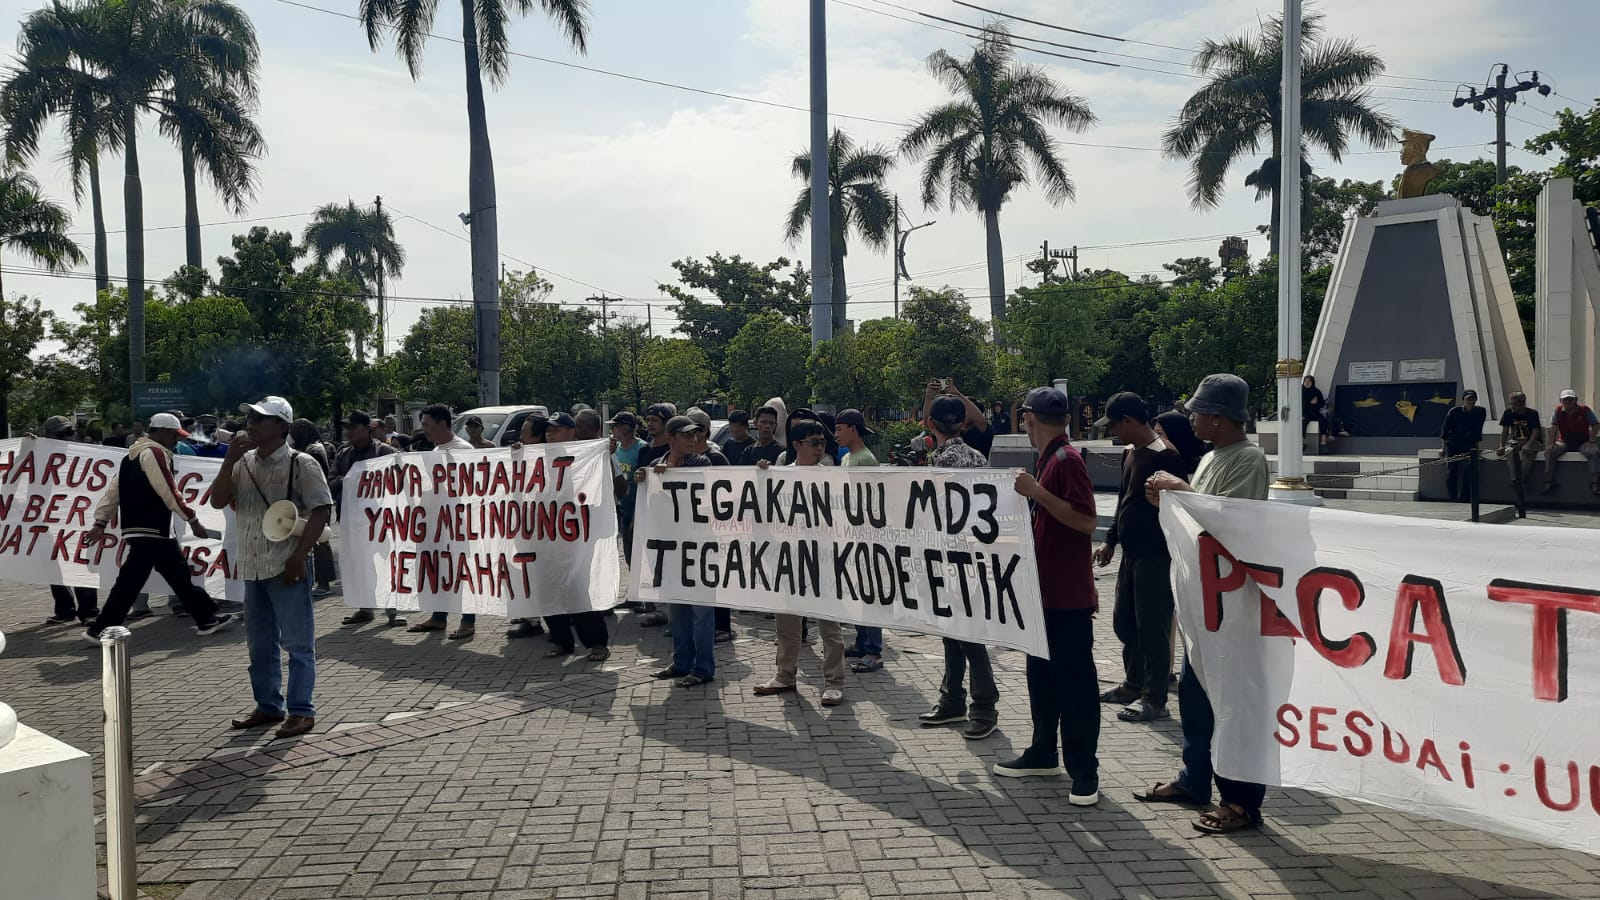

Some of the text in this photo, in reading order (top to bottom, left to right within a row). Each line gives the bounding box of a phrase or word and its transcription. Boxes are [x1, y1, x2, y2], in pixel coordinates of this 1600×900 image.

[357, 456, 574, 498] HANYA PENJAHAT
[365, 506, 426, 543] YANG
[663, 479, 833, 529] TEGAKAN
[844, 482, 886, 528] UU
[905, 479, 999, 545] MD3
[647, 539, 821, 598] TEGAKAN
[834, 541, 917, 610] KODE
[1197, 530, 1600, 703] PECAT
[1534, 756, 1600, 816] U
